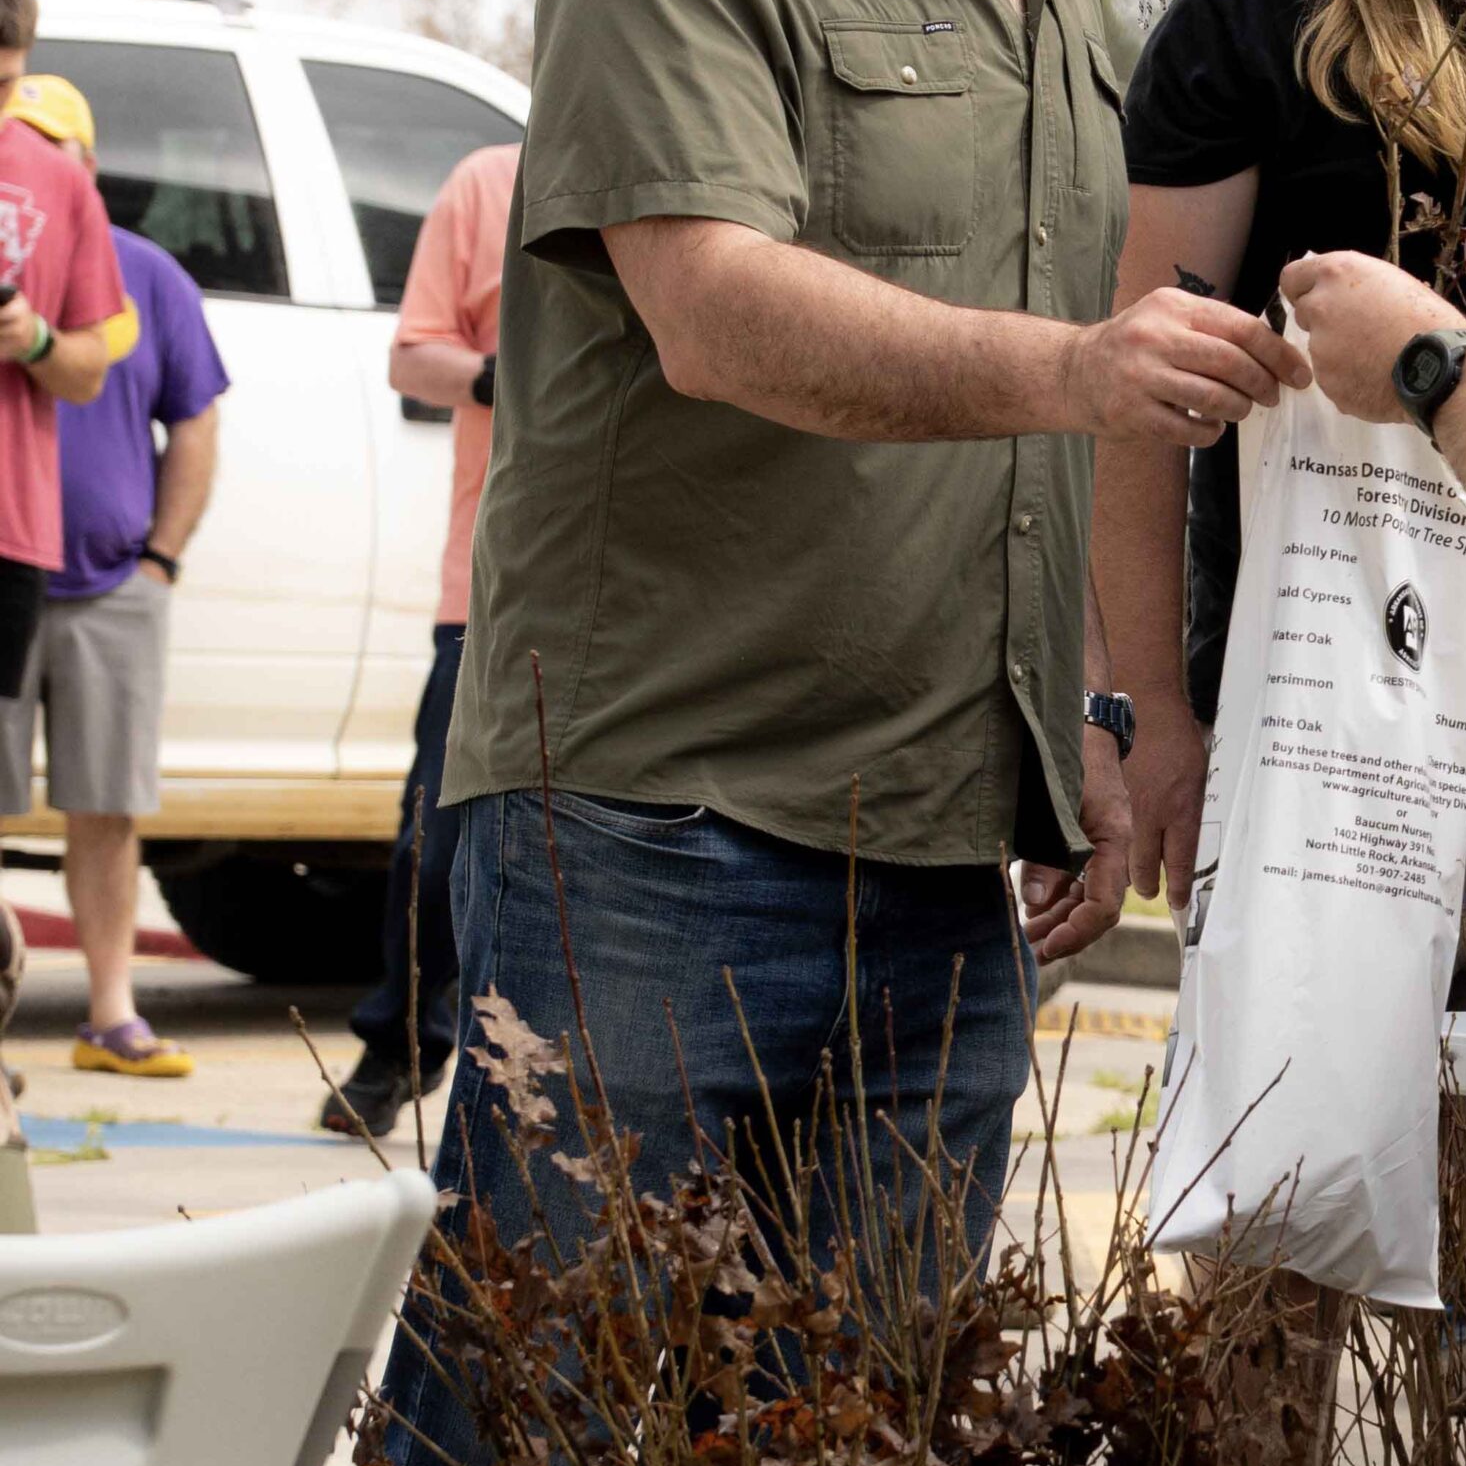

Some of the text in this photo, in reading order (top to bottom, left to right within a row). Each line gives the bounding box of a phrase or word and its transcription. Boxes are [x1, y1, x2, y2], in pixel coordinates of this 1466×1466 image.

[1290, 455, 1358, 478] Arkansas
[1361, 462, 1444, 495] Department
[1321, 508, 1341, 525] 10
[1343, 511, 1378, 528] Most
[1423, 527, 1453, 548] Tree
[1282, 544, 1358, 564] oblolly Pine
[1277, 586, 1352, 605] ald Cypress
[1306, 632, 1332, 646] Oak
[1296, 718, 1323, 733] Oak
[1272, 741, 1412, 773] Buy these trees and other
[1260, 756, 1310, 772] Arkansas
[1313, 762, 1380, 783] Department
[1382, 773, 1395, 785] of
[1396, 808, 1408, 818] or
[1355, 815, 1399, 833] Baucum
[1334, 827, 1357, 841] 1402
[1359, 832, 1407, 851] Highway
[1305, 838, 1338, 853] North
[1340, 843, 1366, 858] Little
[1368, 849, 1398, 865] Rock,
[1263, 864, 1298, 878] email:
